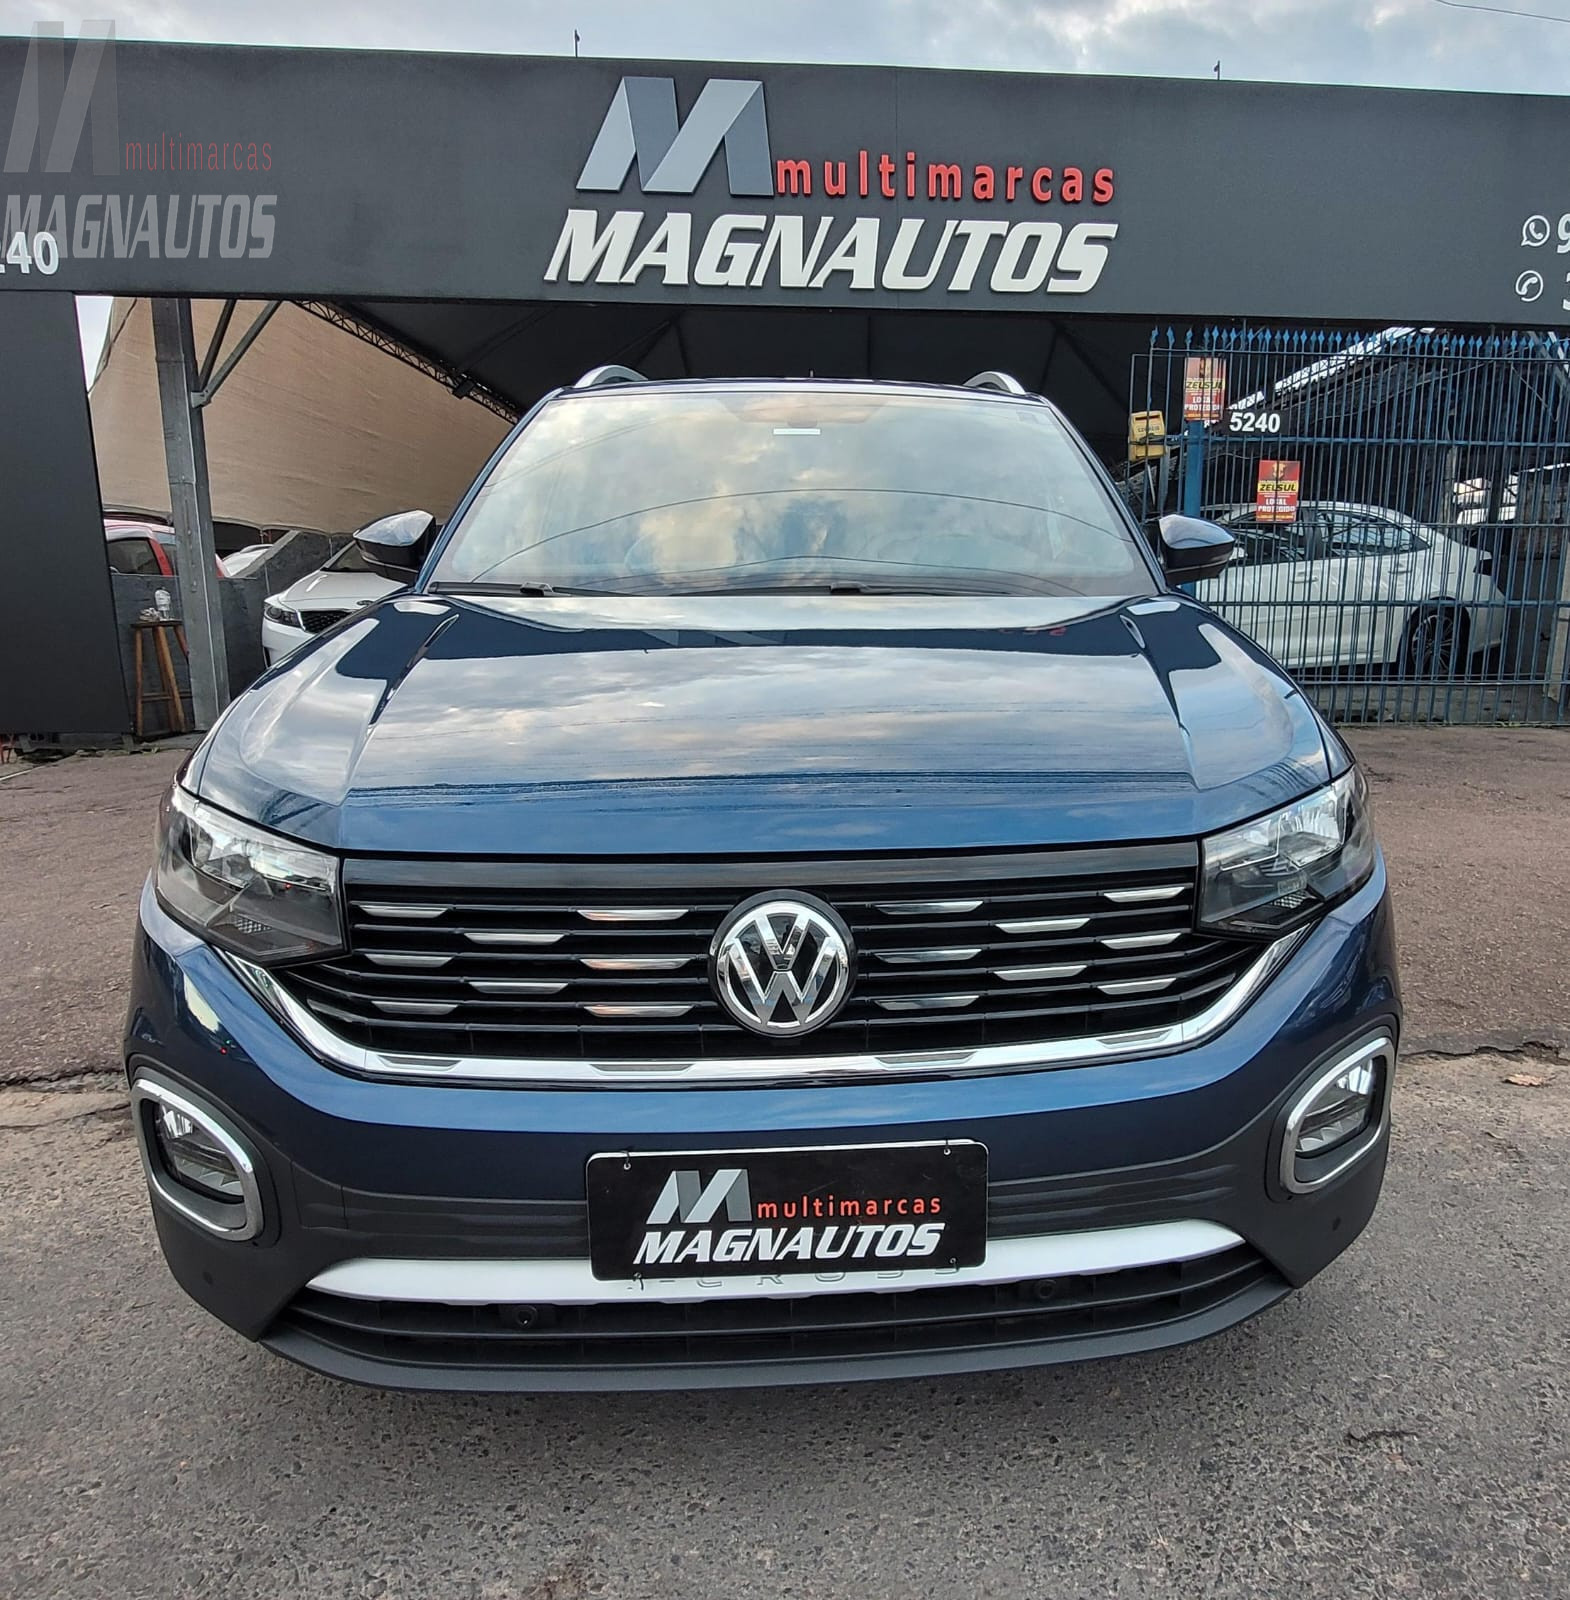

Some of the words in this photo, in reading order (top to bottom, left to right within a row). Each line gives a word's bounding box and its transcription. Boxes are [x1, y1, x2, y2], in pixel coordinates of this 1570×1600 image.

[776, 150, 1115, 203] multimarcas
[0, 231, 59, 275] 40
[543, 208, 1119, 294] MAGNAUTOS
[1229, 412, 1281, 433] 5240
[1259, 483, 1297, 492] ZELSUL
[757, 1195, 942, 1219] multimarcas
[633, 1222, 946, 1265] MAGNAUTOS
